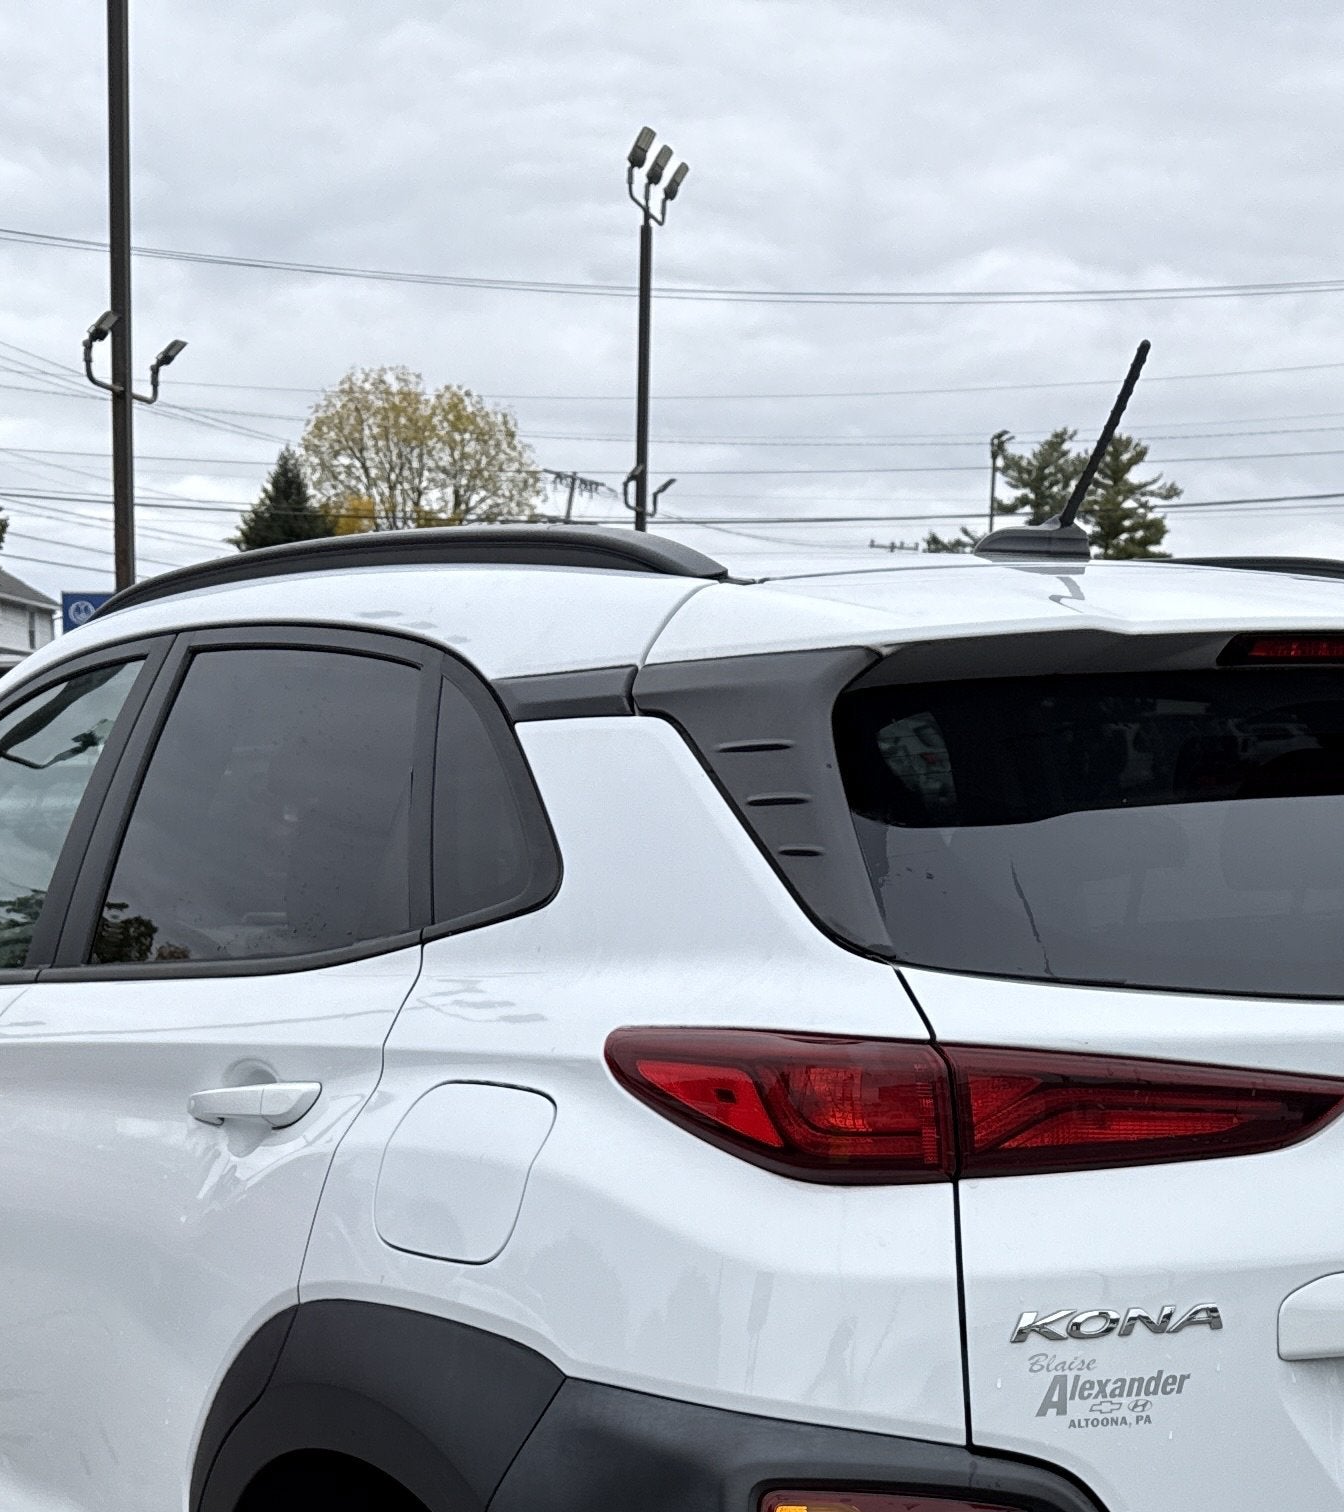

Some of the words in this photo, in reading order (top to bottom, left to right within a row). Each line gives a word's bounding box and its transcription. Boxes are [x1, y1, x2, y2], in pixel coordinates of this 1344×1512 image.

[1010, 1302, 1223, 1343] KONA
[1028, 1353, 1098, 1373] Blaise
[1035, 1370, 1191, 1417] Alexander
[1068, 1416, 1132, 1429] ALTOONA,
[1136, 1414, 1152, 1425] PA
